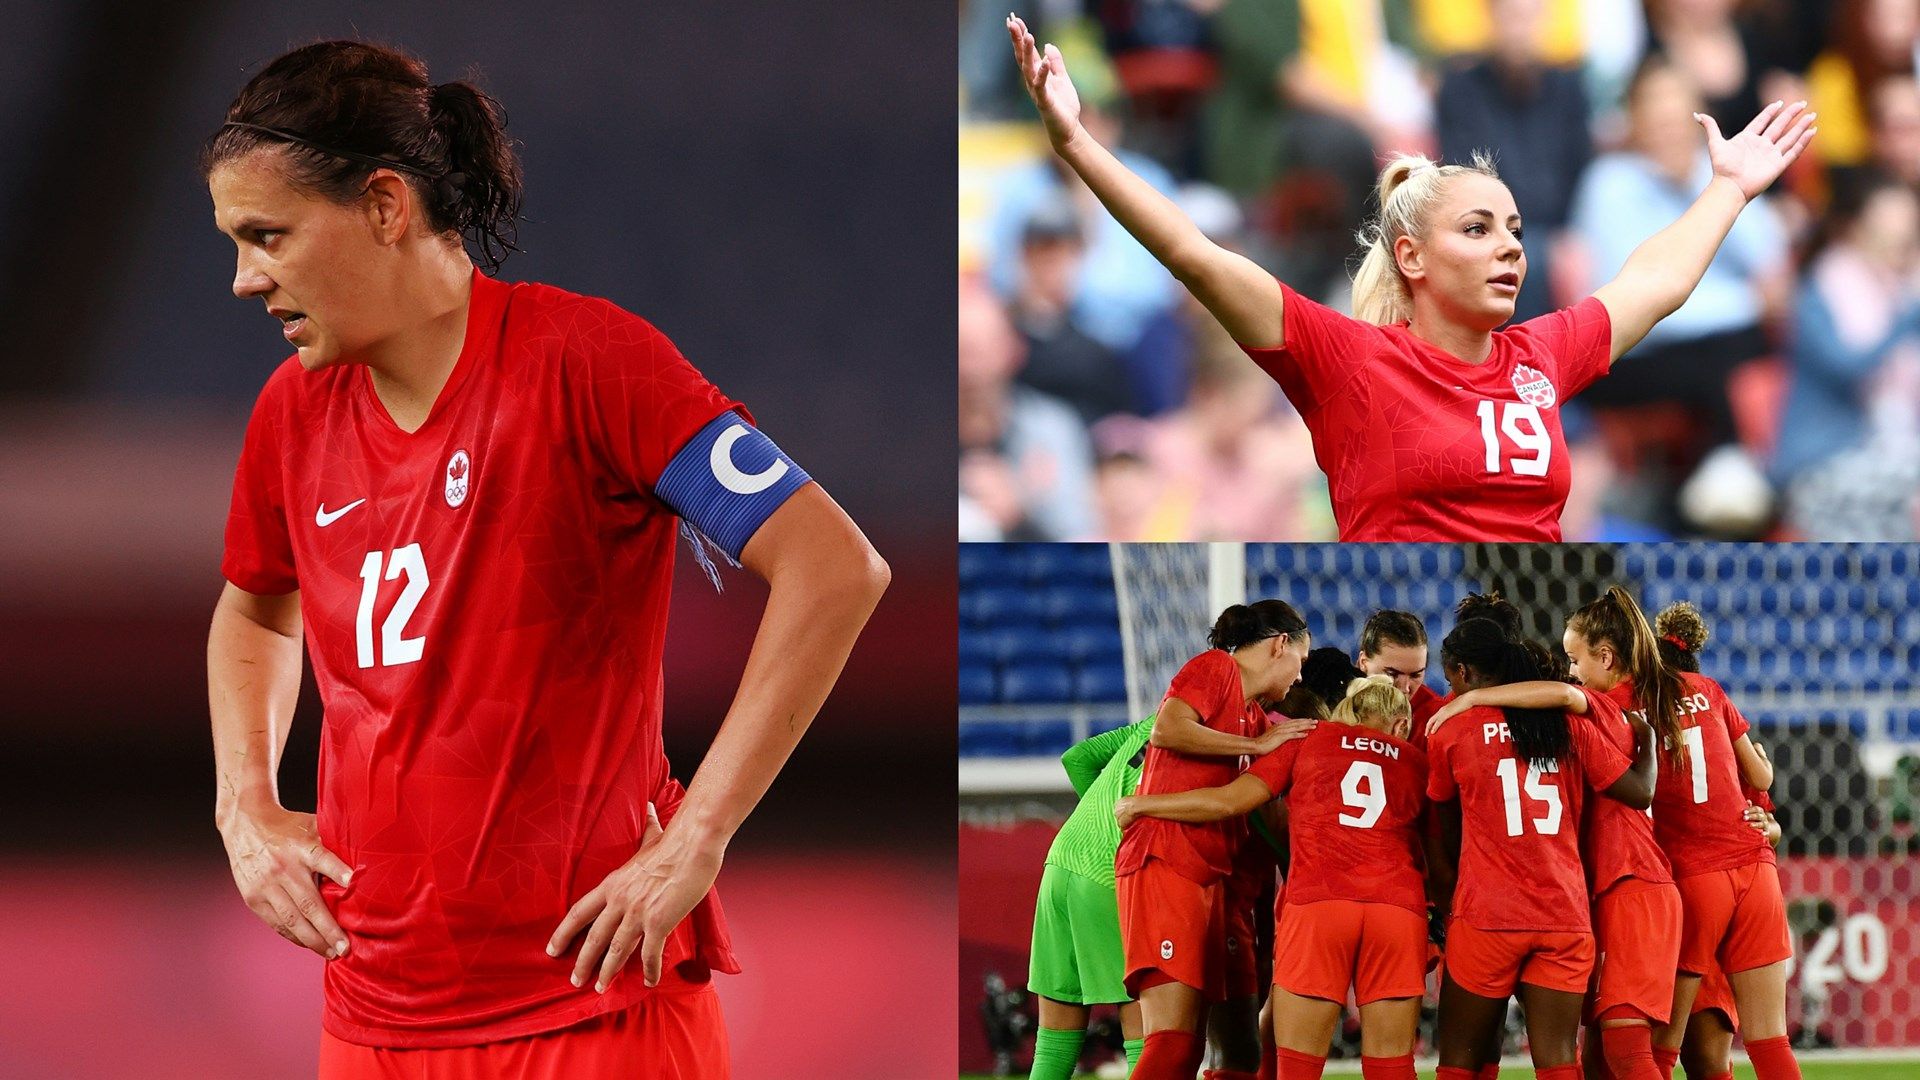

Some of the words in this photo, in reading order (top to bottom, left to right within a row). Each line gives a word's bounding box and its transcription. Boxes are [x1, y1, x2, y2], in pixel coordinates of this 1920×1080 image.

[1517, 380, 1550, 395] CANADA
[709, 423, 790, 495] C
[1476, 400, 1551, 477] 19
[356, 542, 430, 669] 12
[1341, 736, 1399, 760] LEON
[1338, 760, 1387, 829] 9
[1496, 757, 1563, 837] 15
[1787, 912, 1889, 986] 20
